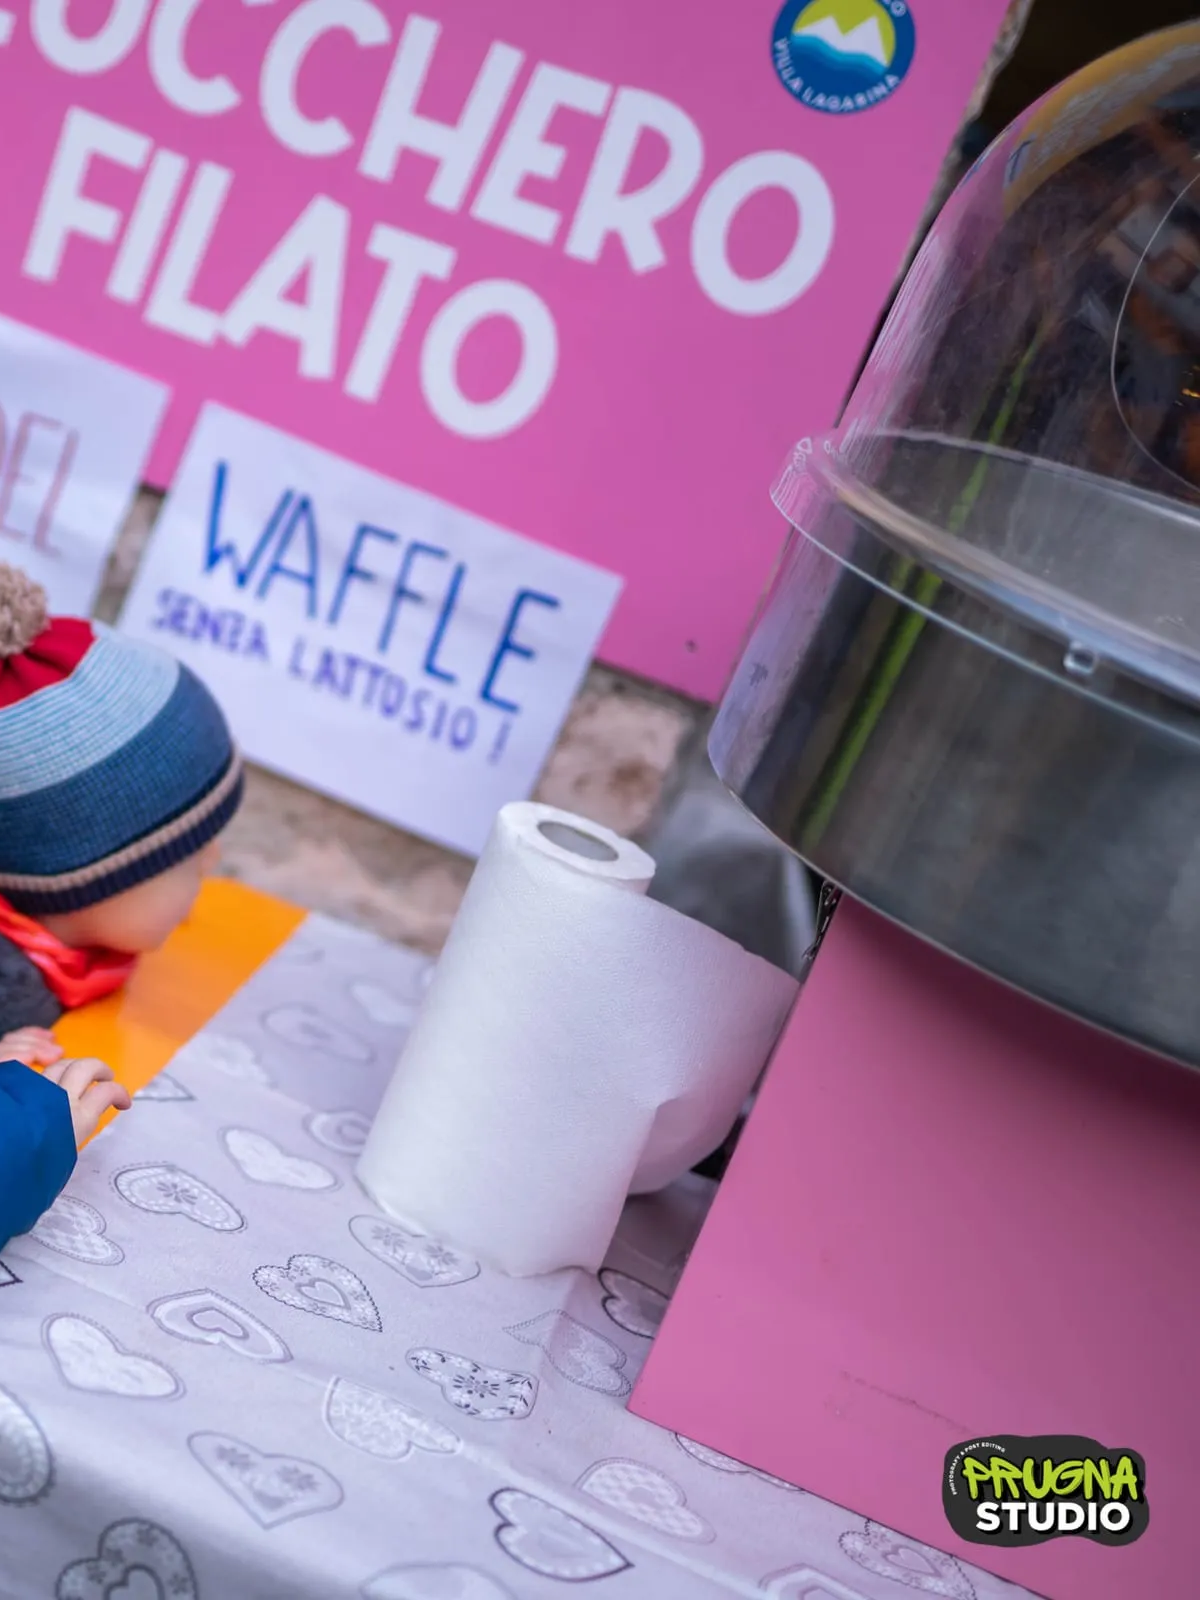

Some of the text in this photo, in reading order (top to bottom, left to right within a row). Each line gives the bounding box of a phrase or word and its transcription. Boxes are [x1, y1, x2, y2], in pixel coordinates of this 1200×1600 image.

[802, 74, 899, 113] LAGARINA
[21, 104, 558, 440] FILATO
[150, 587, 271, 662] SENZA
[202, 459, 562, 715] WAFFLE
